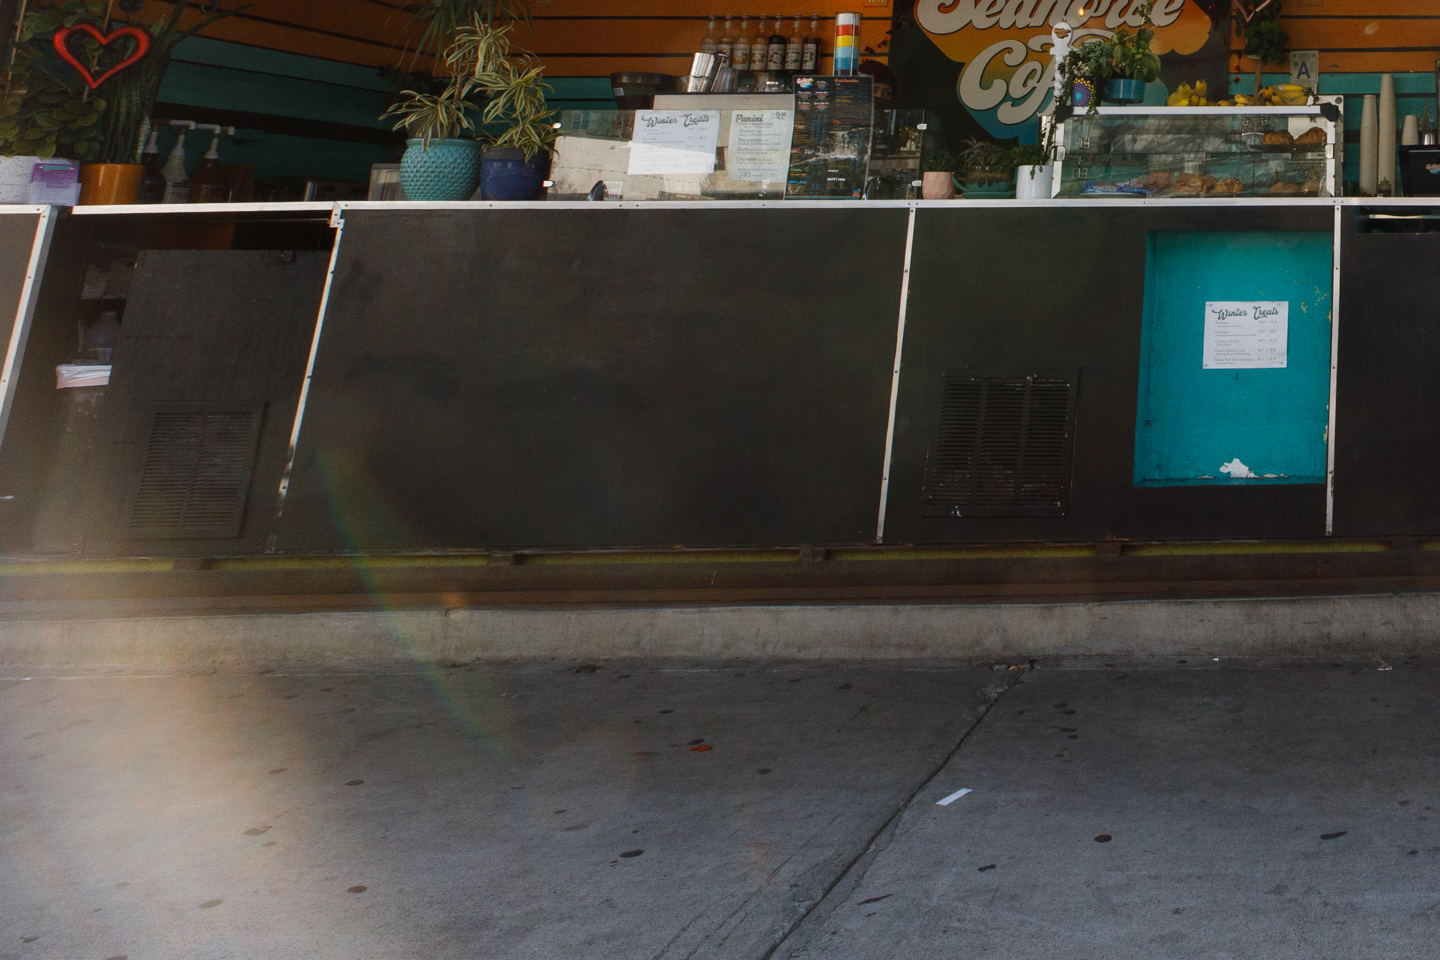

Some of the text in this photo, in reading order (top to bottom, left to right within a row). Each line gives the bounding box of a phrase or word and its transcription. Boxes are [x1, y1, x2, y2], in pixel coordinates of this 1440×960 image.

[1296, 60, 1311, 79] A
[641, 114, 710, 127] Winter Treats
[735, 114, 764, 122] Panini
[1212, 305, 1279, 320] Winter Treats
